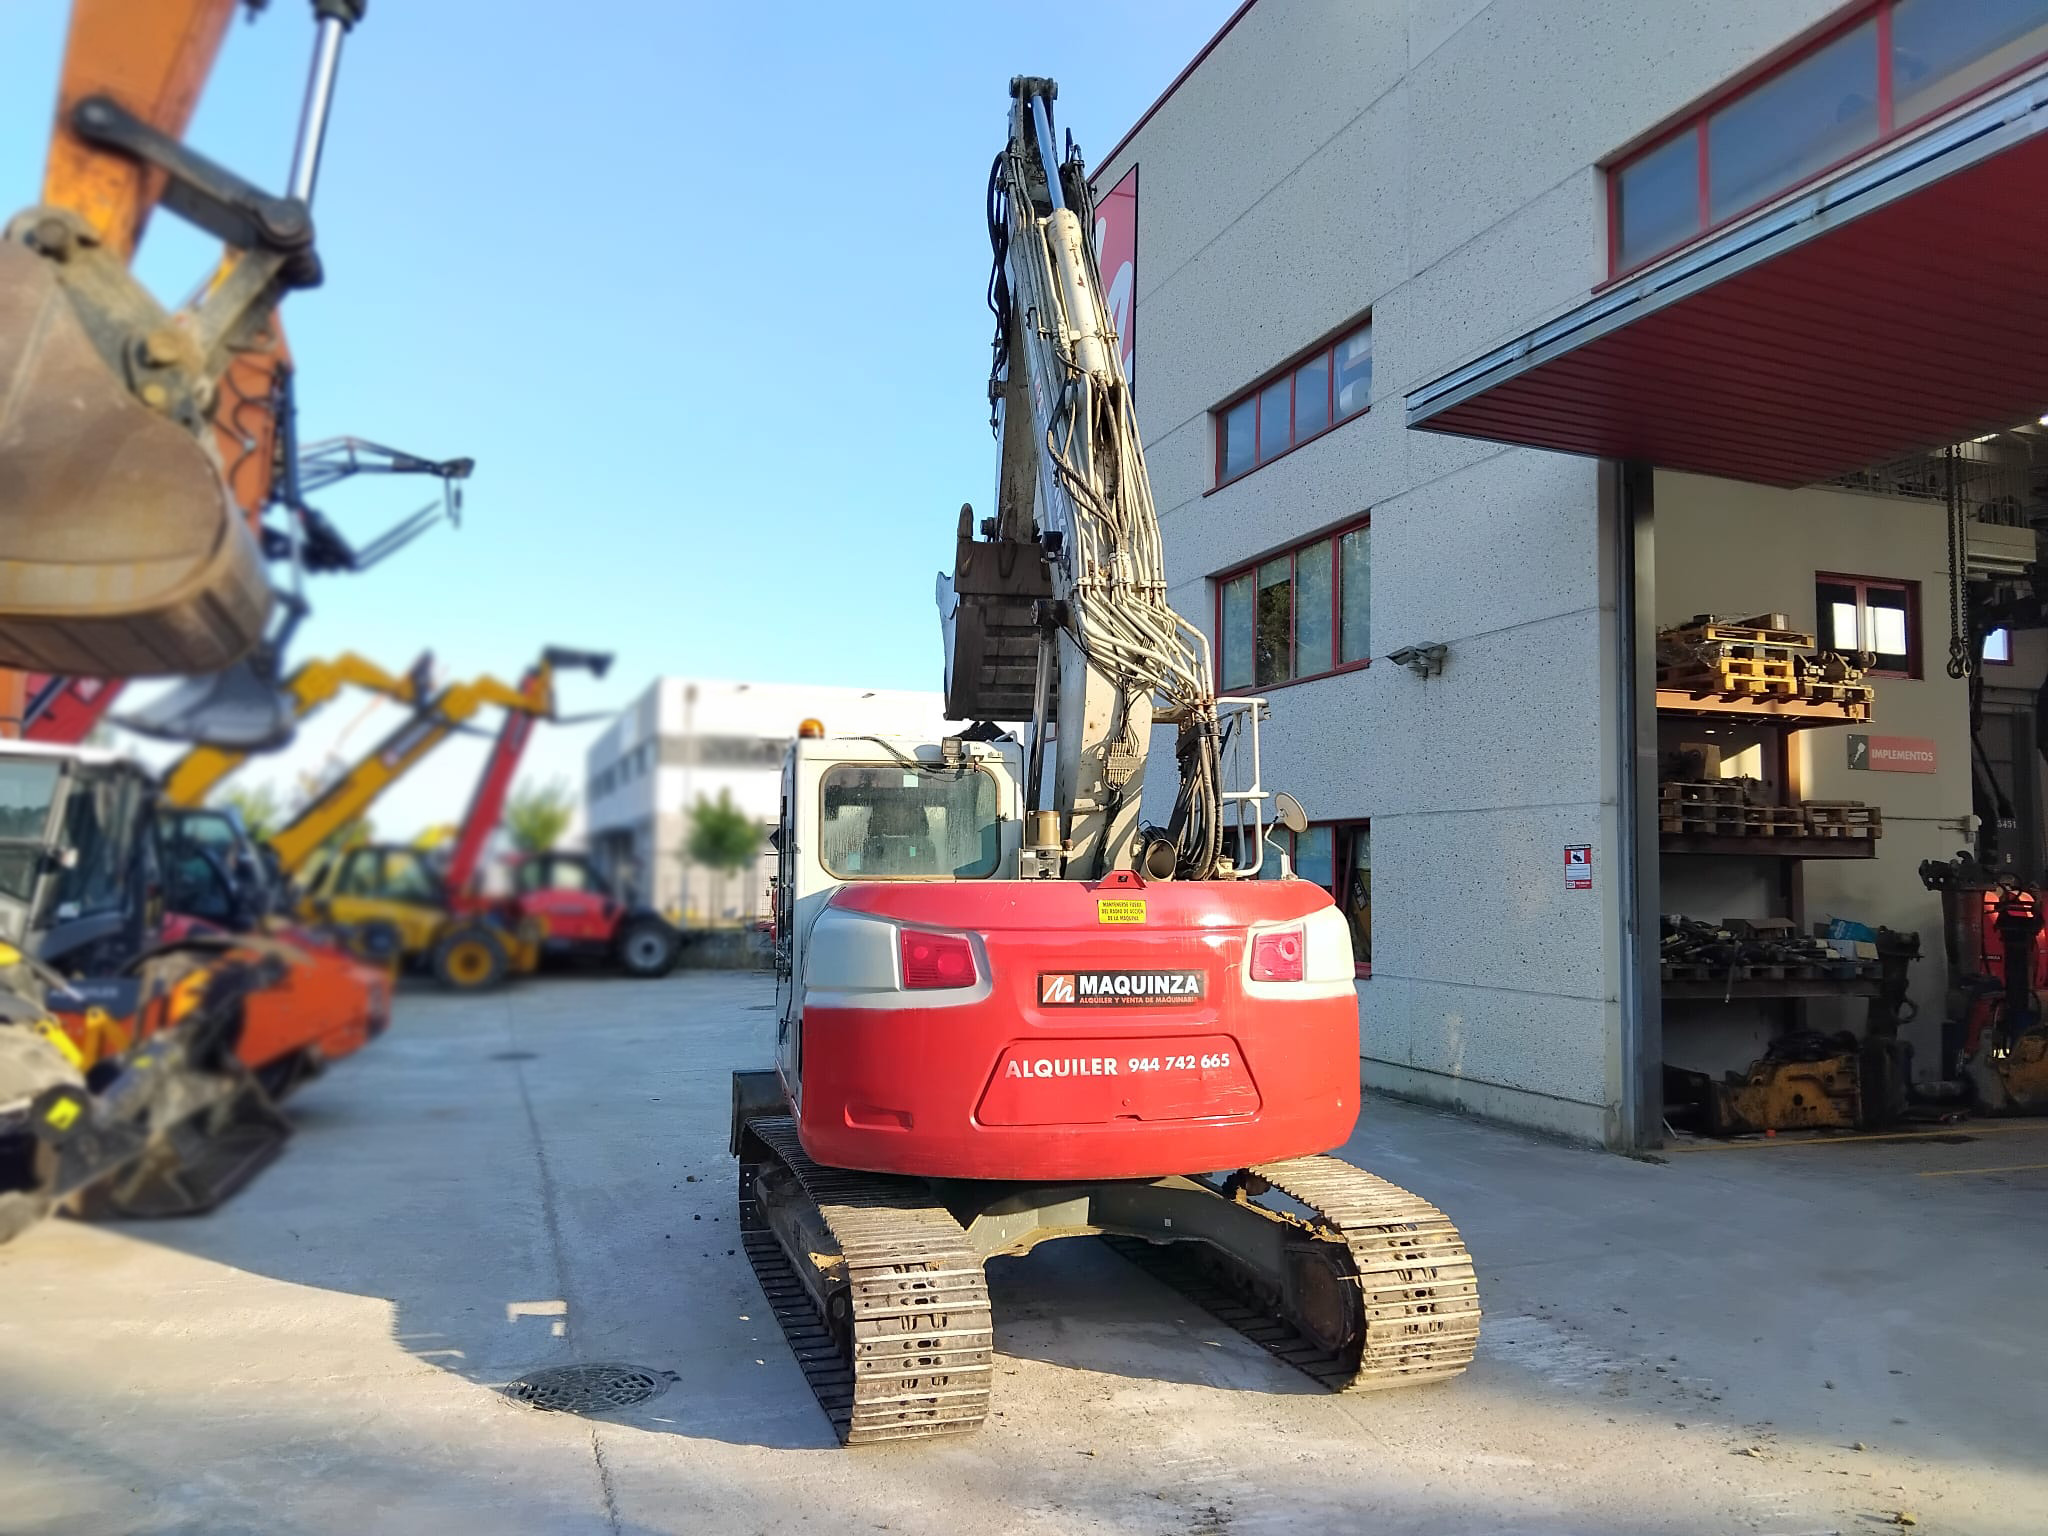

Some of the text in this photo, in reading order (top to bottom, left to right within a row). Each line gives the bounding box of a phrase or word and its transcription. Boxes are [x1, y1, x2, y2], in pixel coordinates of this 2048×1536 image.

[1871, 748, 1934, 762] IMPLEMENTOS
[1079, 975, 1200, 995] MAQUINZA
[1080, 996, 1113, 1004] ALQUILER
[1005, 1053, 1230, 1078] ALQUILER 944 742 665
